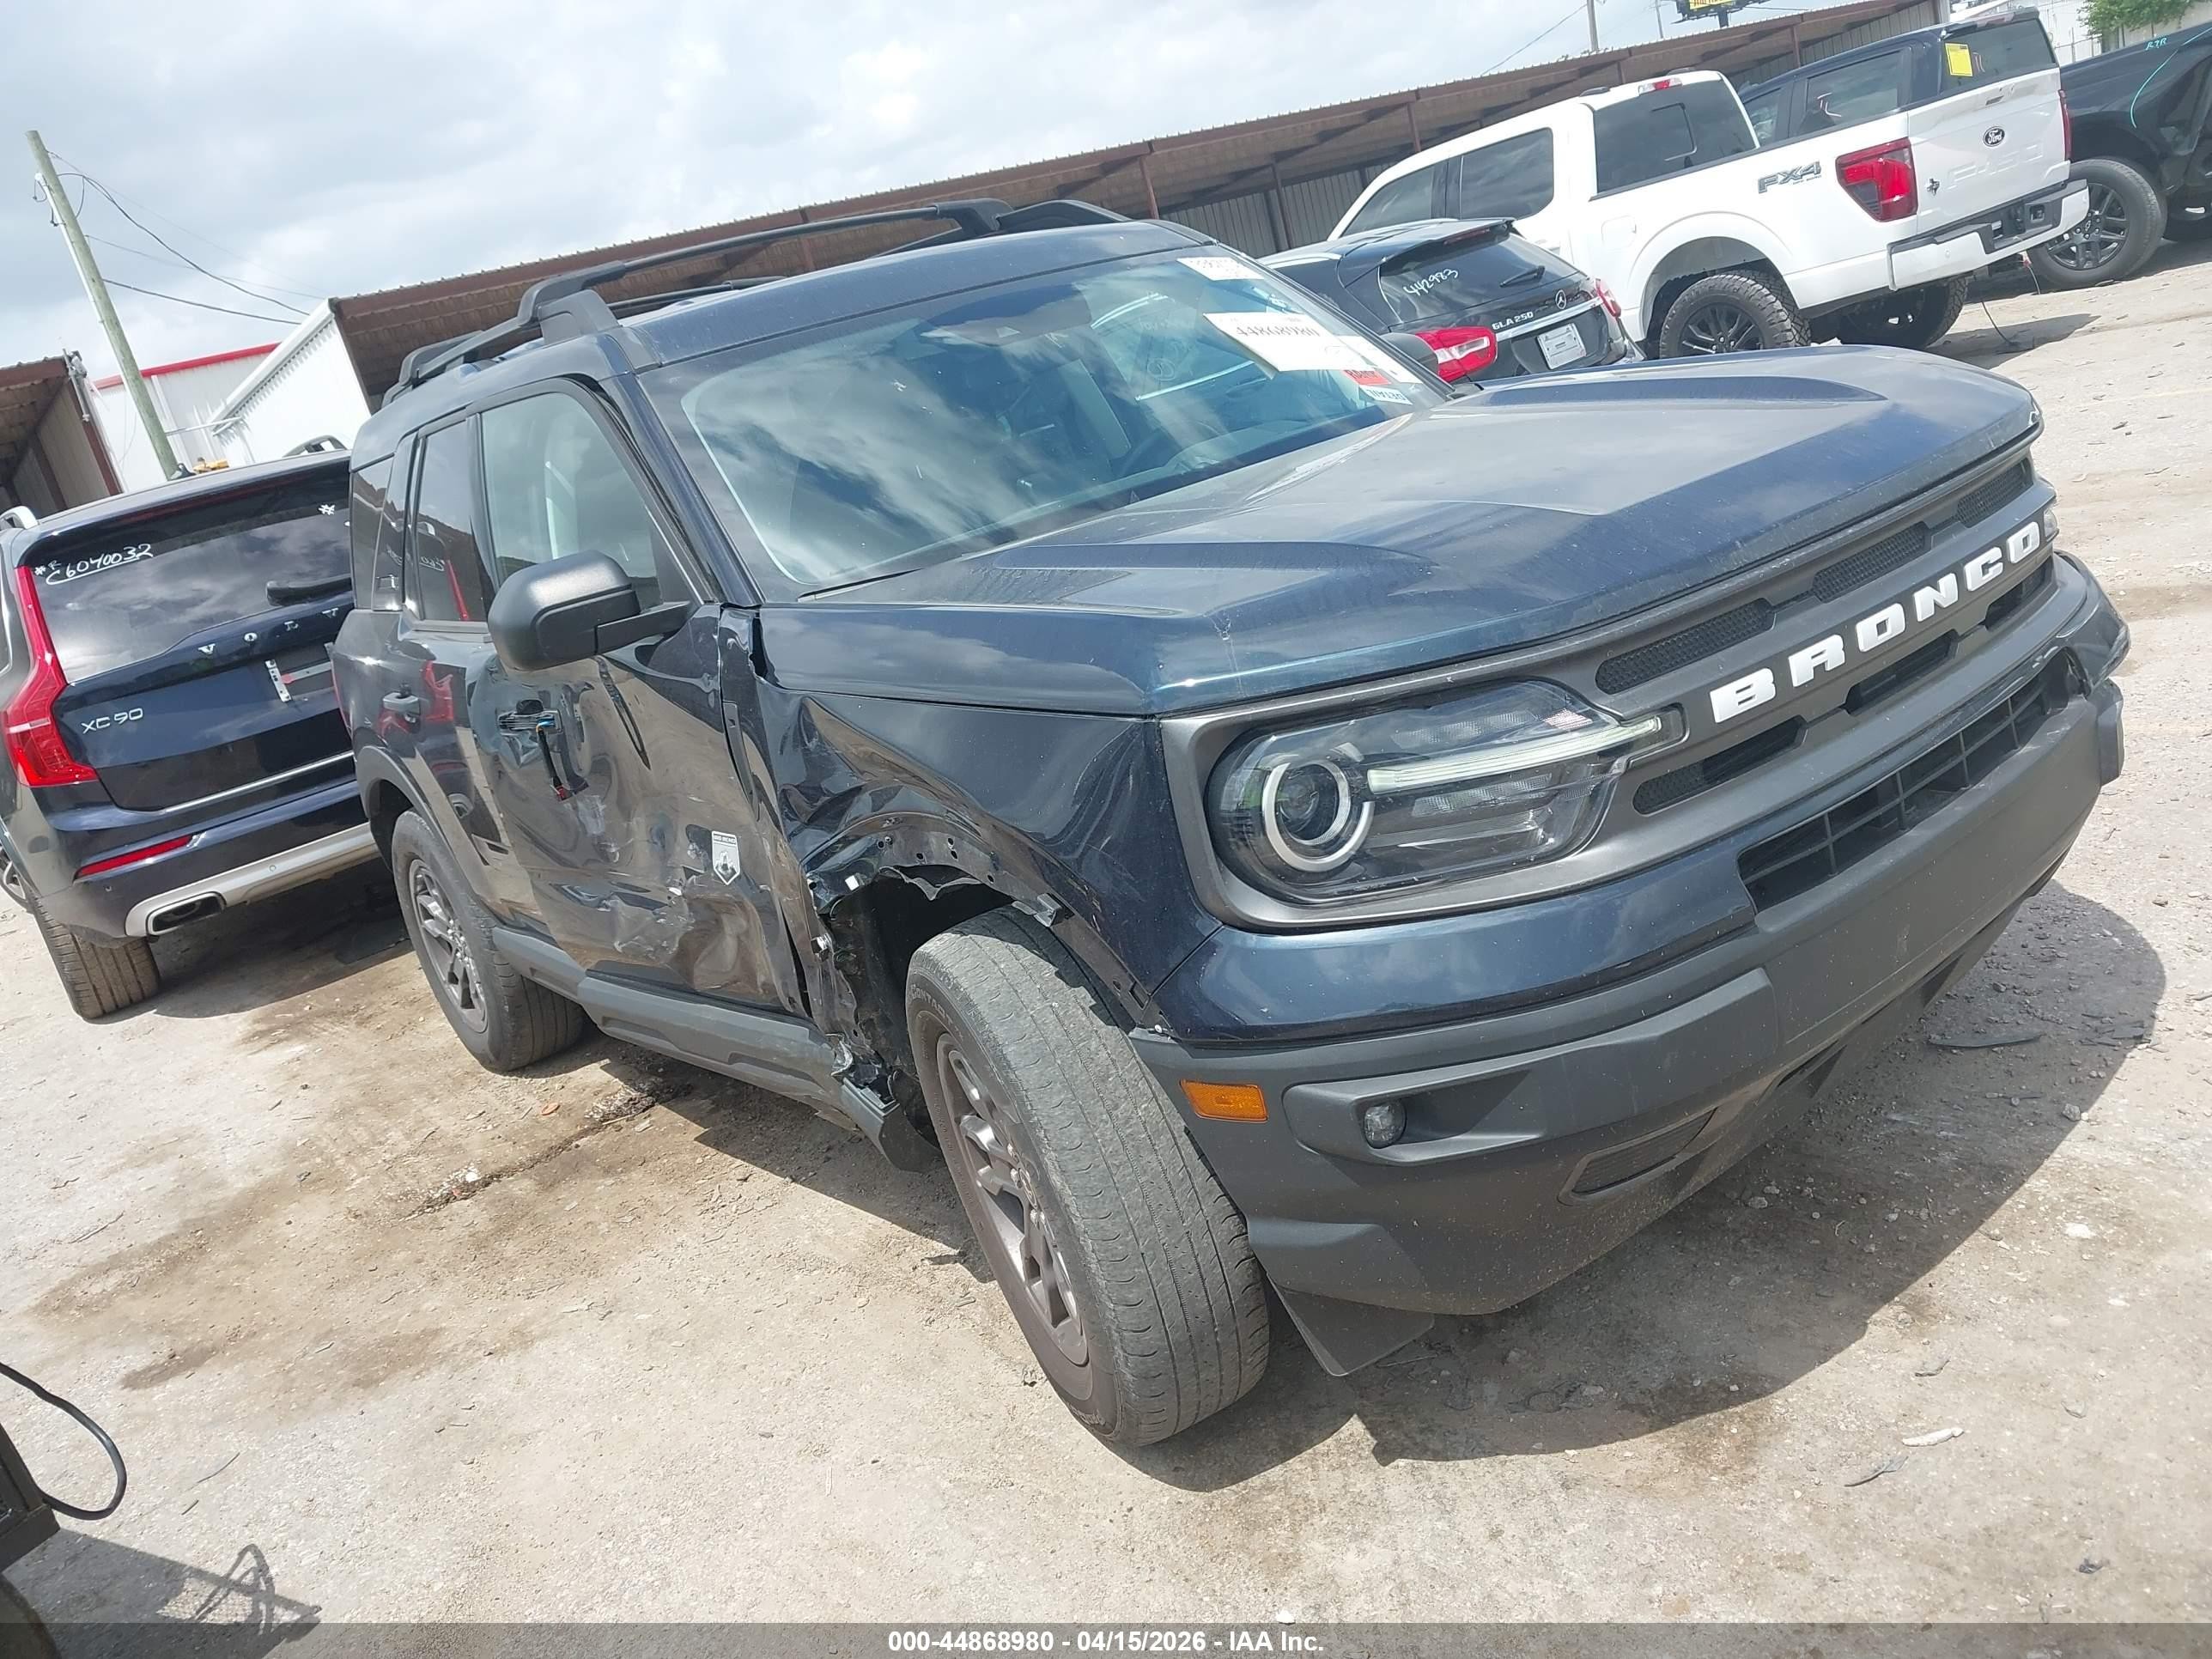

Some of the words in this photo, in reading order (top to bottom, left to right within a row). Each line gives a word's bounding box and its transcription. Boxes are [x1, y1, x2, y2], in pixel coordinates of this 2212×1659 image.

[1987, 128, 2004, 145] Ford
[1757, 161, 1822, 194] FX4
[1402, 268, 1459, 296] 442983
[1492, 318, 1515, 331] GLA
[1514, 311, 1534, 324] 250
[1709, 520, 2041, 723] BRONCO
